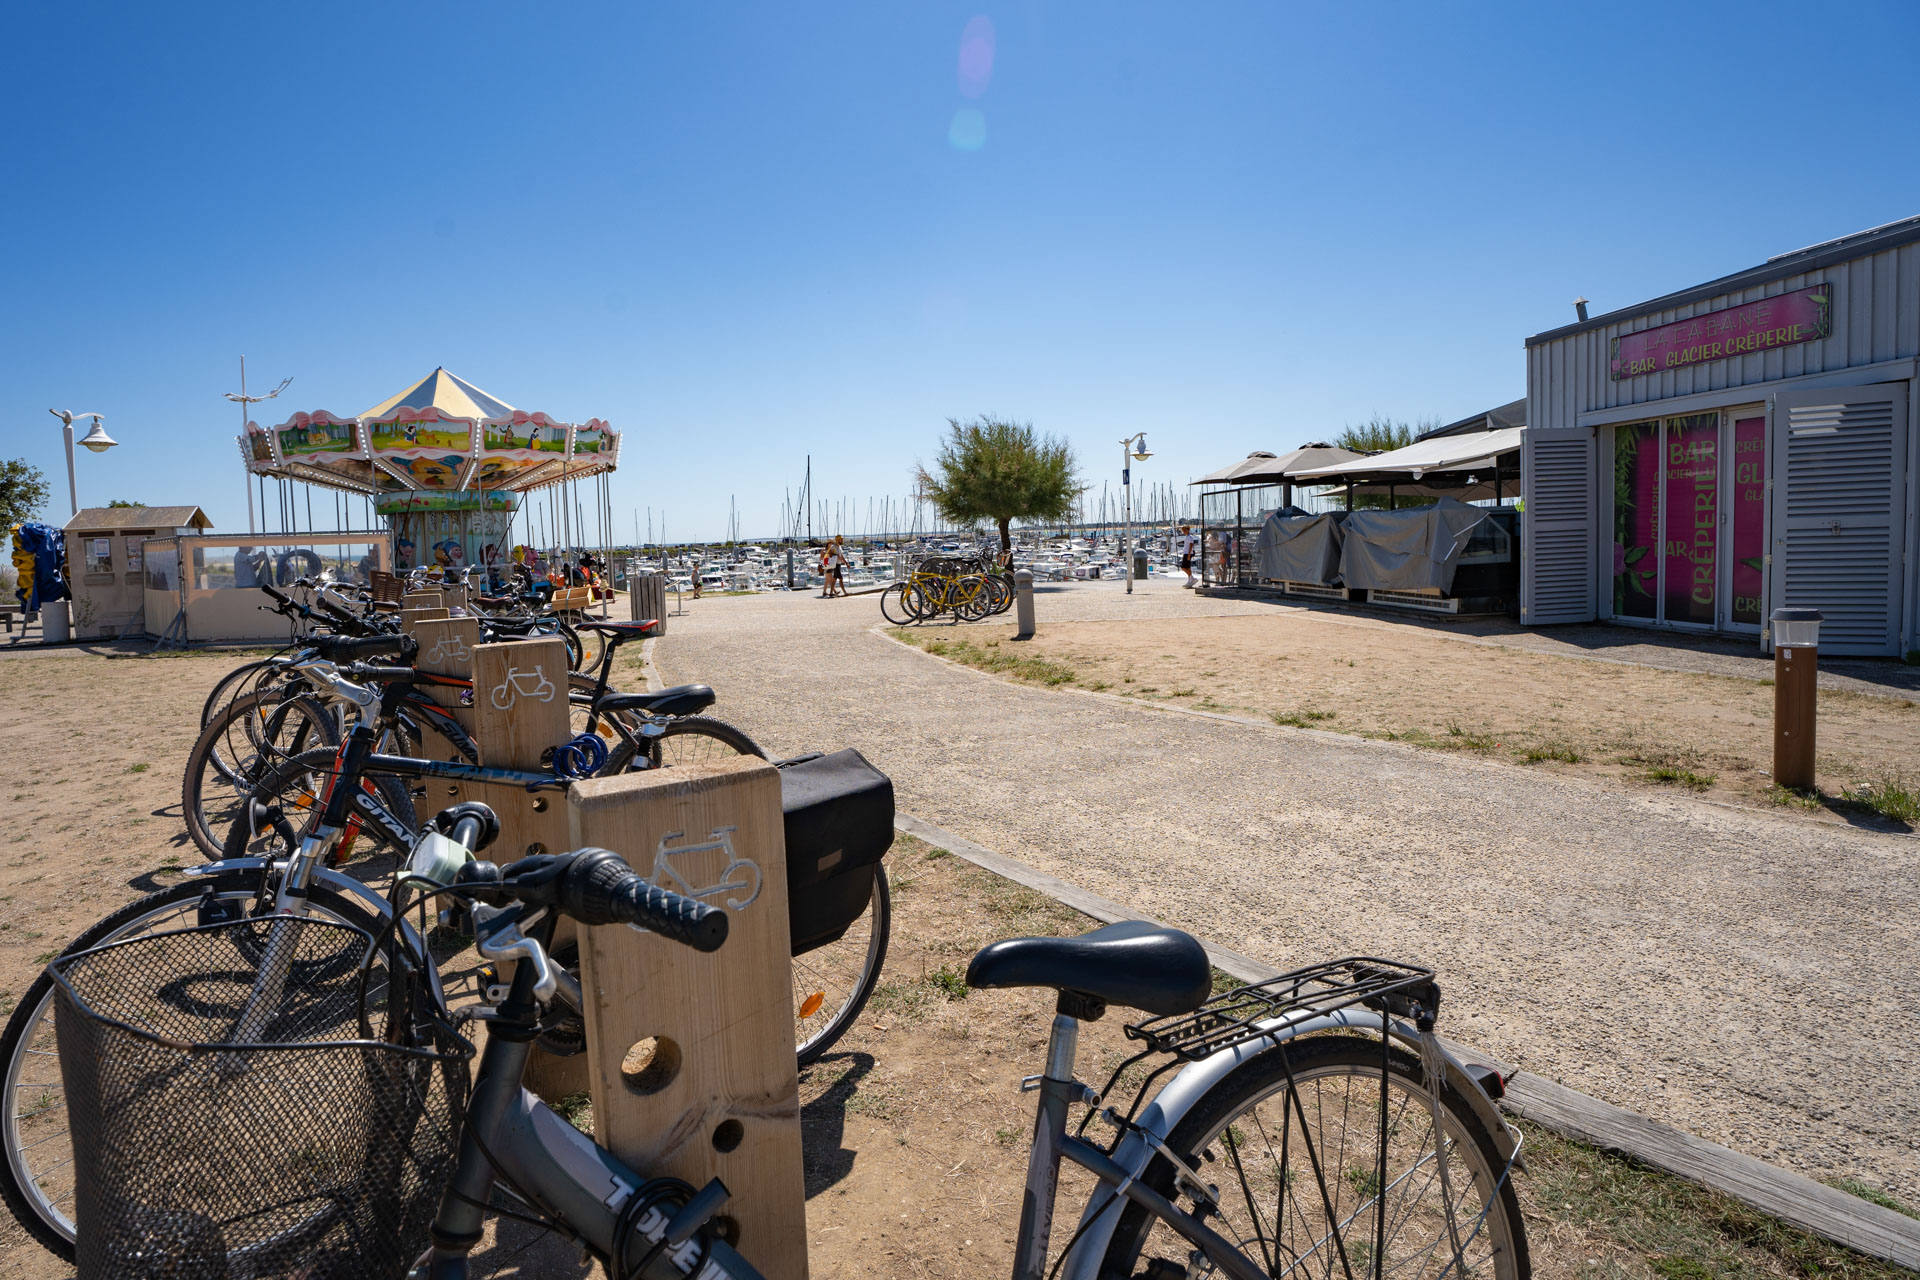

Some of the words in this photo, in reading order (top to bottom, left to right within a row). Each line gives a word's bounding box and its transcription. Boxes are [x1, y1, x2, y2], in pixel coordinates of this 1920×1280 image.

[1630, 357, 1657, 375] BAR
[1666, 342, 1722, 367] GLACIER
[1725, 323, 1803, 355] CRÊPERIE
[1643, 331, 1668, 351] LA
[1674, 304, 1772, 345] CABANE
[1669, 440, 1717, 465] BAR
[1688, 464, 1717, 605] CRÊPERIE
